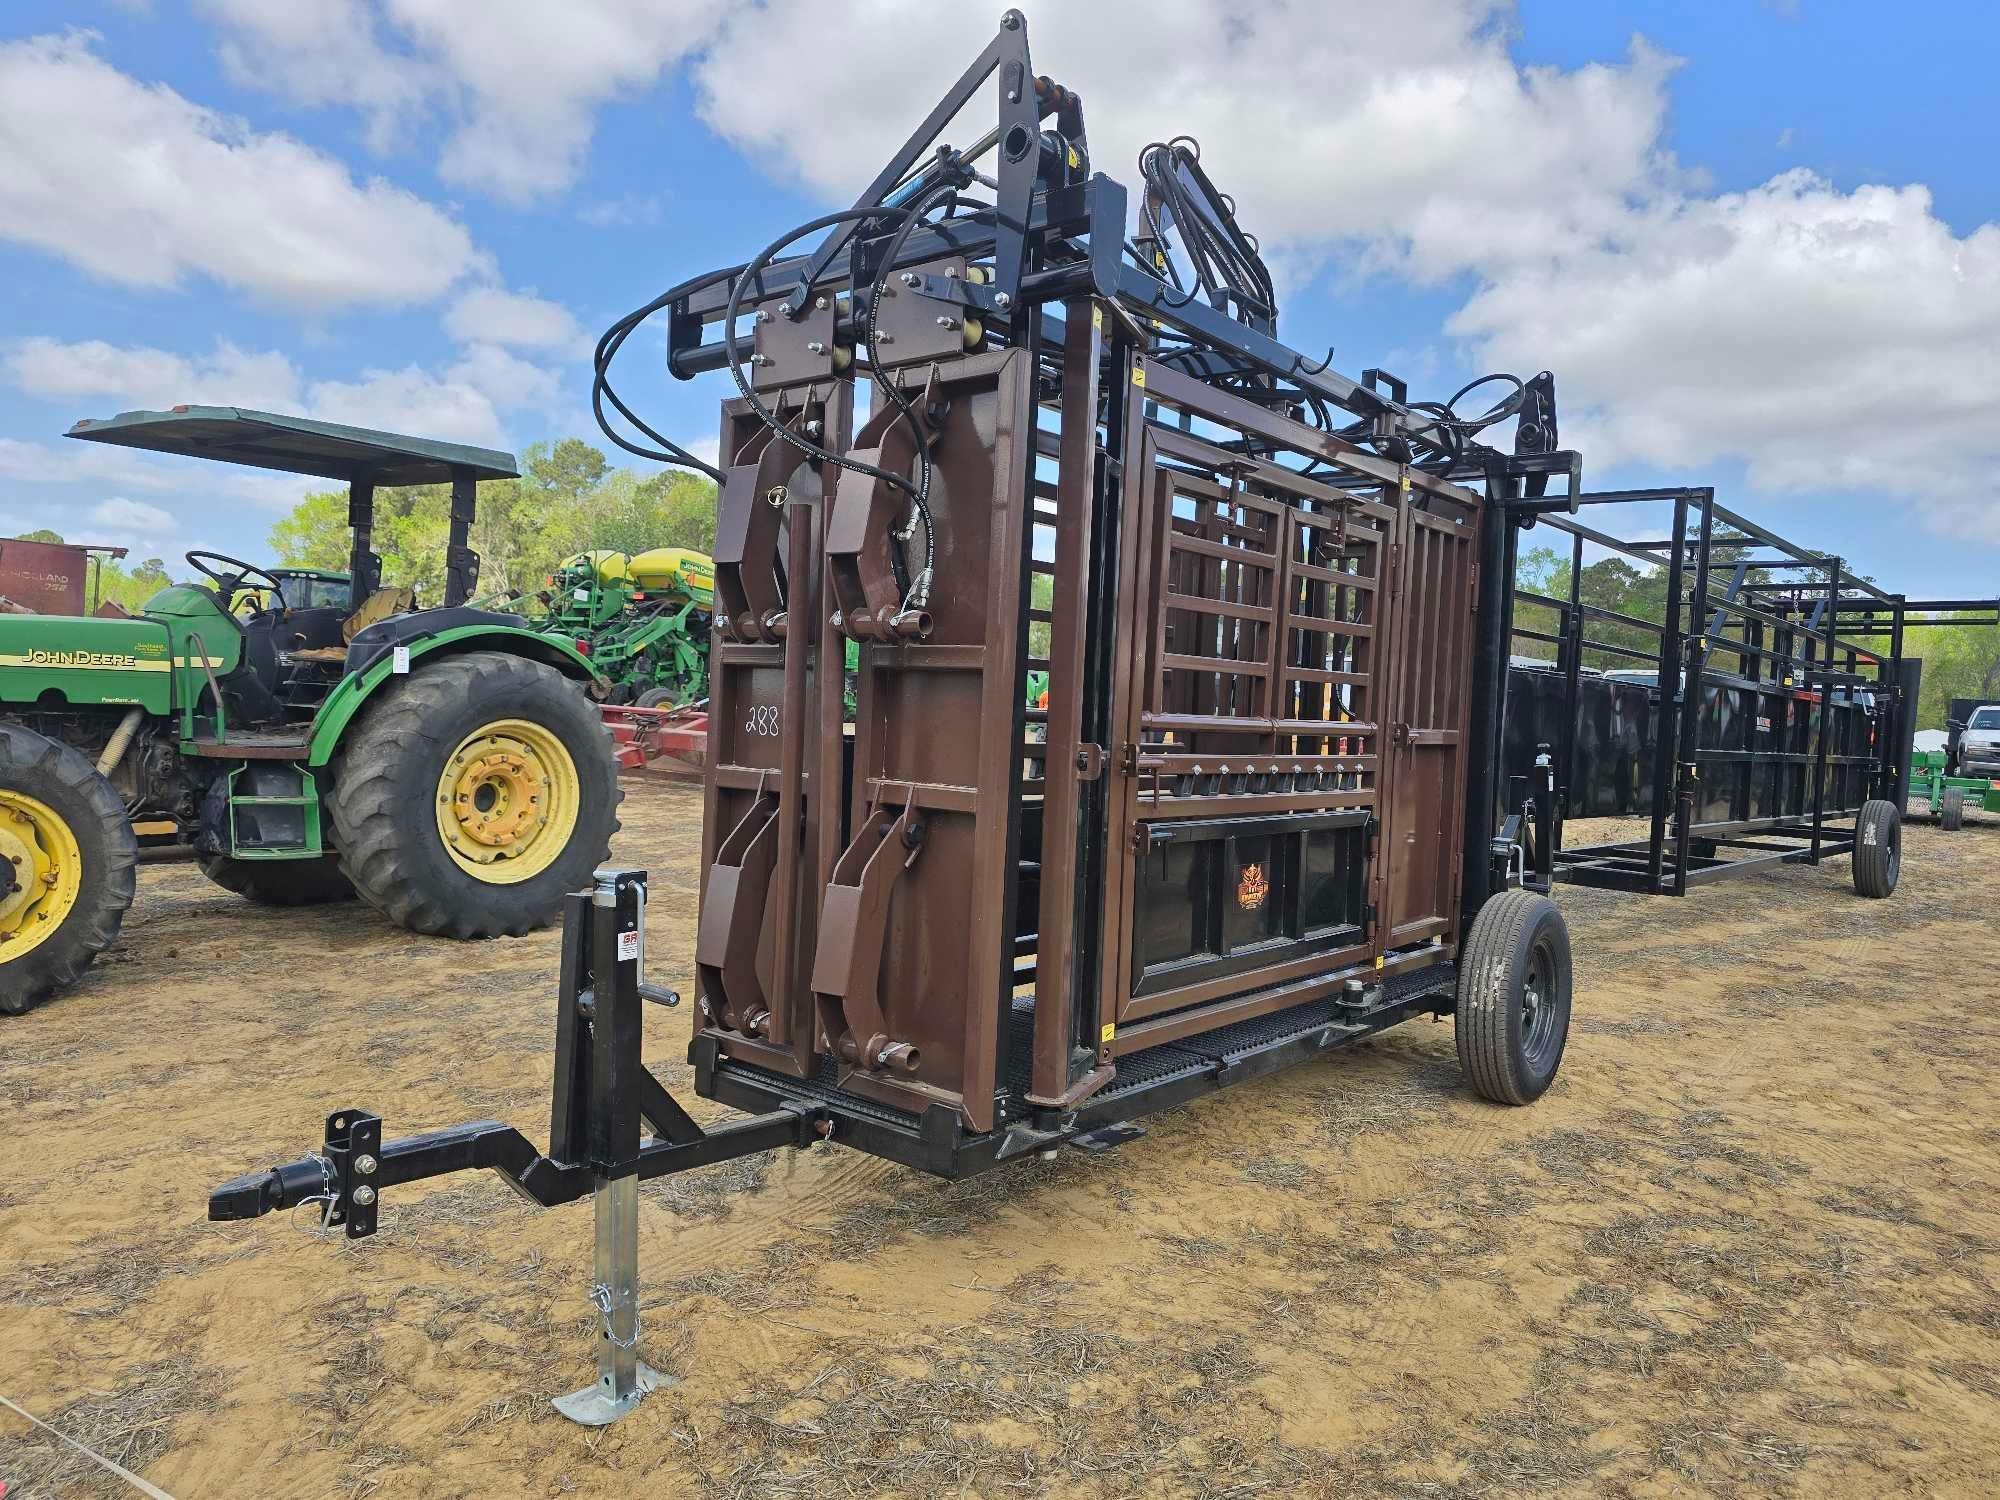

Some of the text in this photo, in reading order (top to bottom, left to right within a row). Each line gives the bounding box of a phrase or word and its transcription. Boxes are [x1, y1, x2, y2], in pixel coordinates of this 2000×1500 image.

[22, 648, 136, 667] JOHN DEERE
[745, 705, 779, 737] 288
